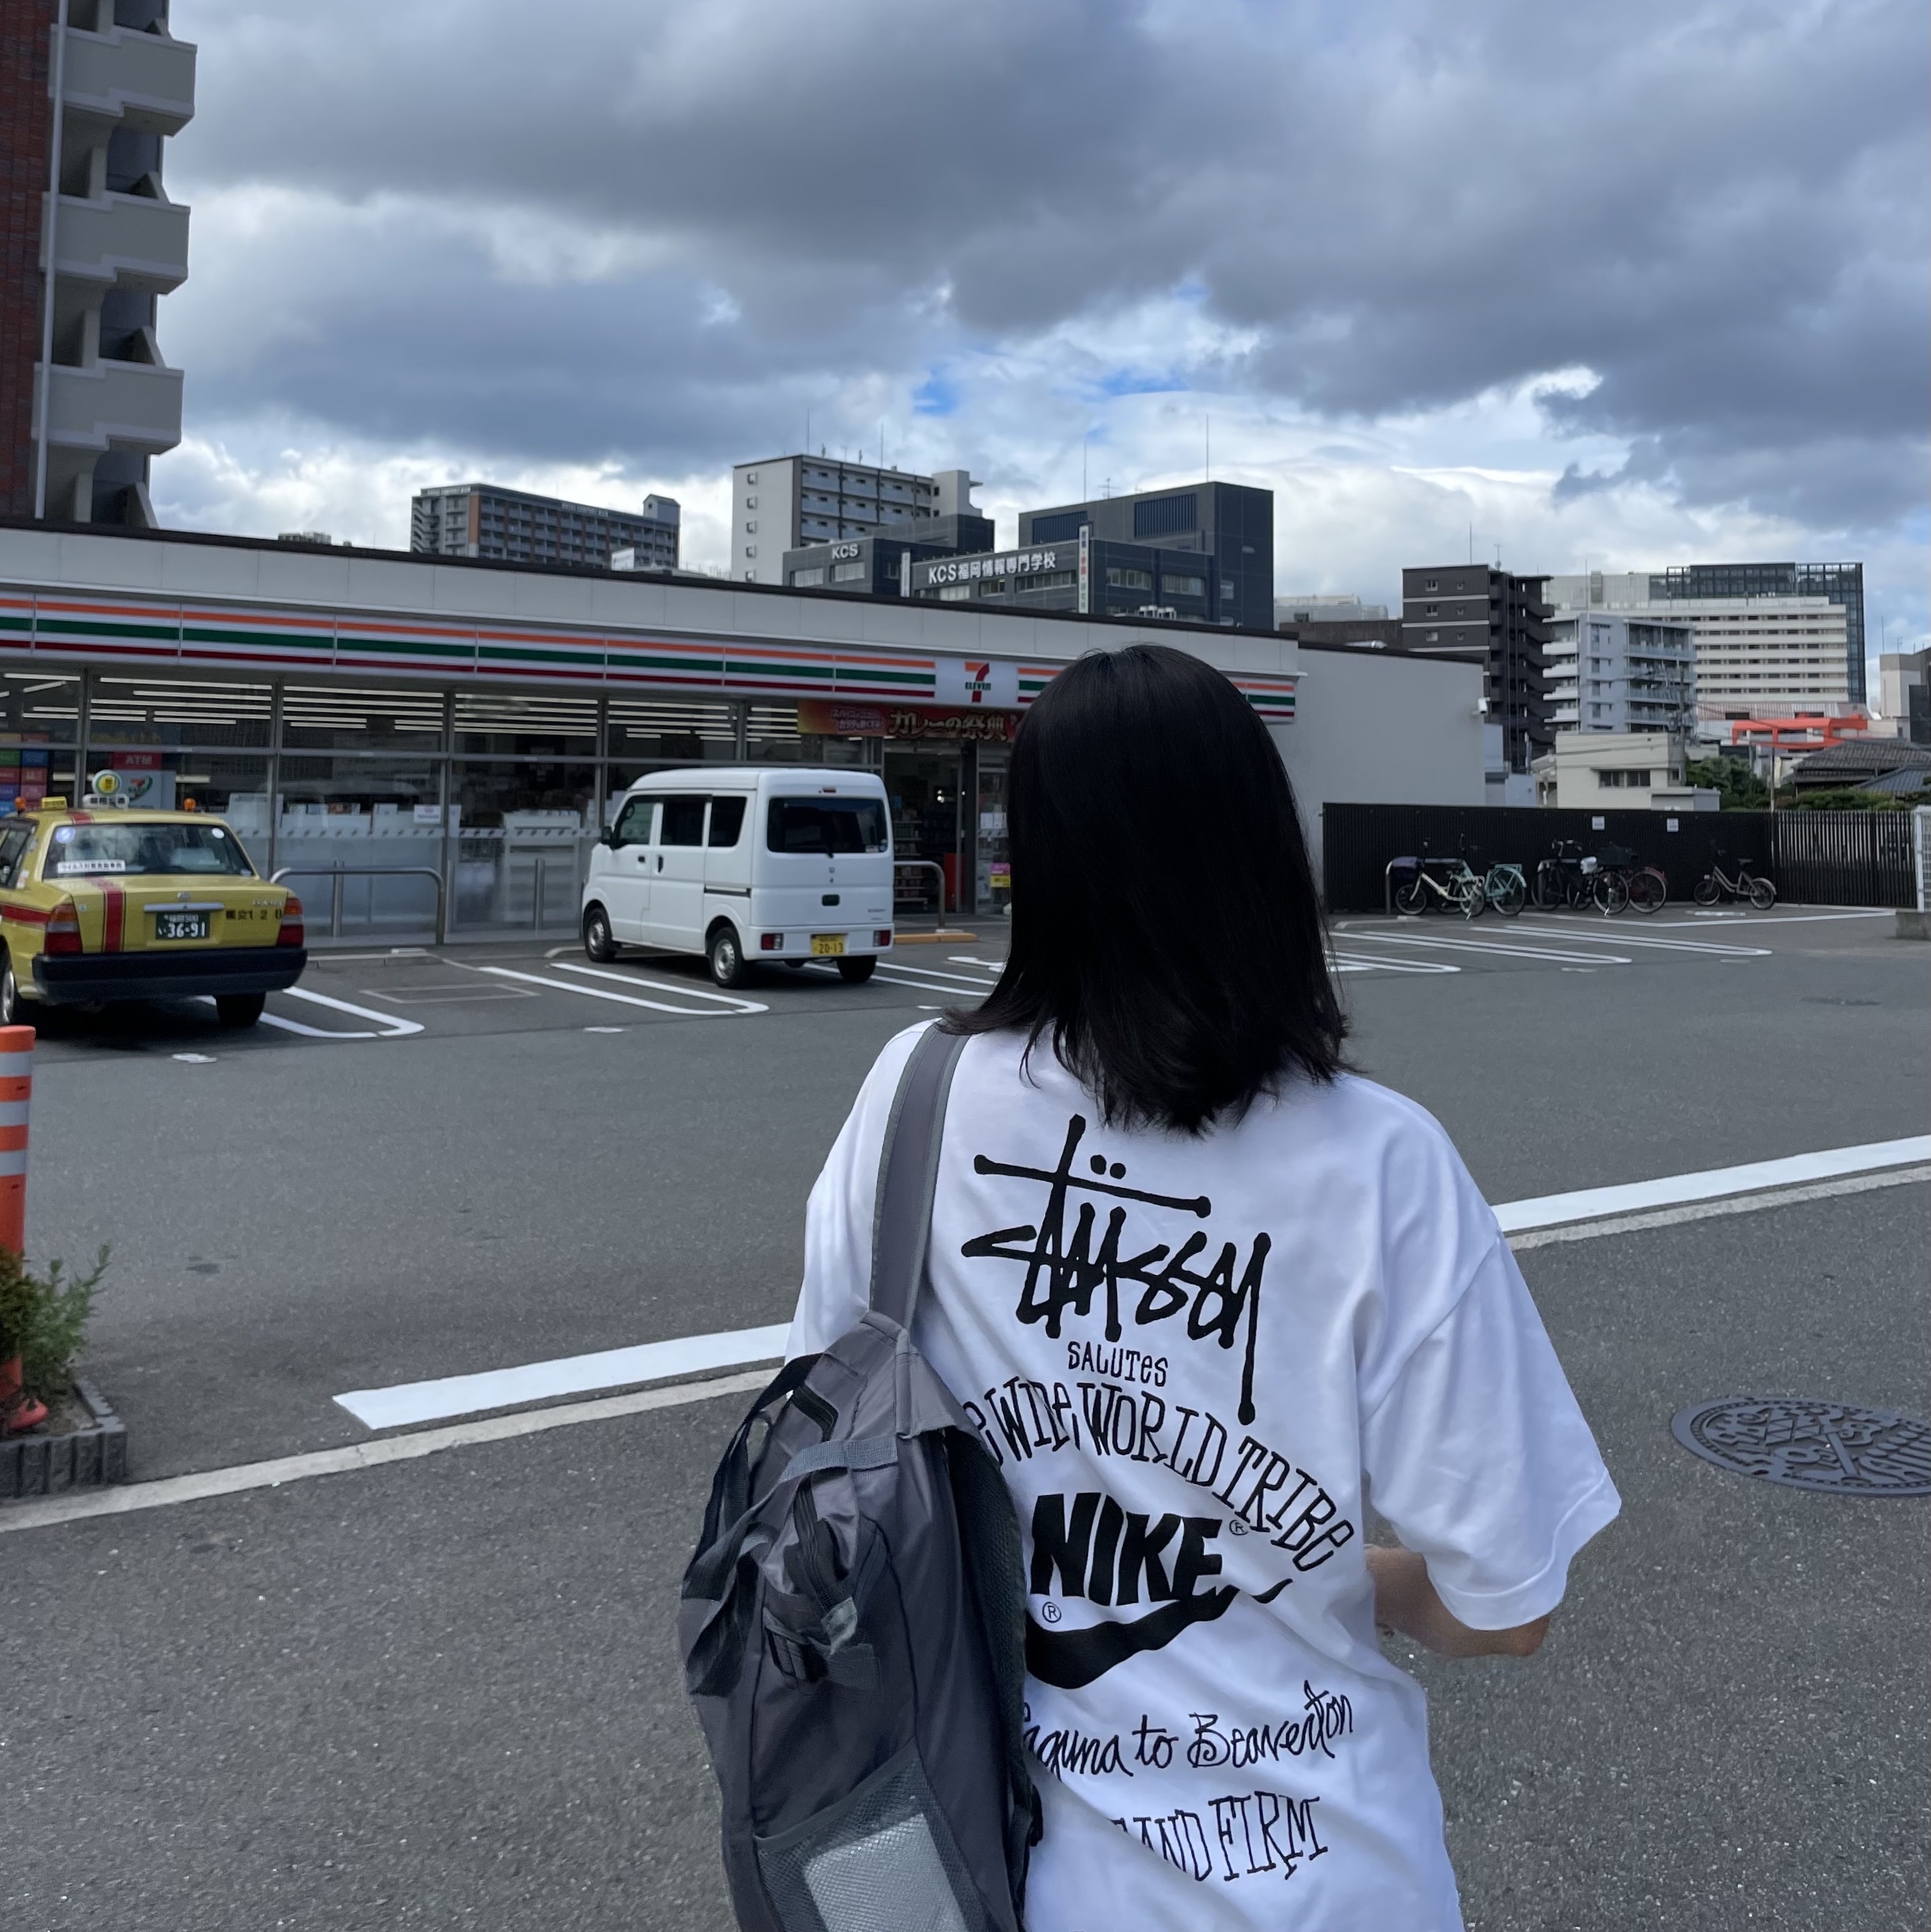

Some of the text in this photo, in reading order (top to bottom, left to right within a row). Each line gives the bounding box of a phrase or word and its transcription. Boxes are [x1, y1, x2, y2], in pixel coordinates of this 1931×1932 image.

[831, 543, 858, 560] KCS
[126, 754, 153, 765] ATM
[1076, 1381, 1228, 1487] WORLD
[1030, 1492, 1223, 1606] NIKE
[1132, 1714, 1179, 1769] to
[1208, 1790, 1328, 1880] FIRM
